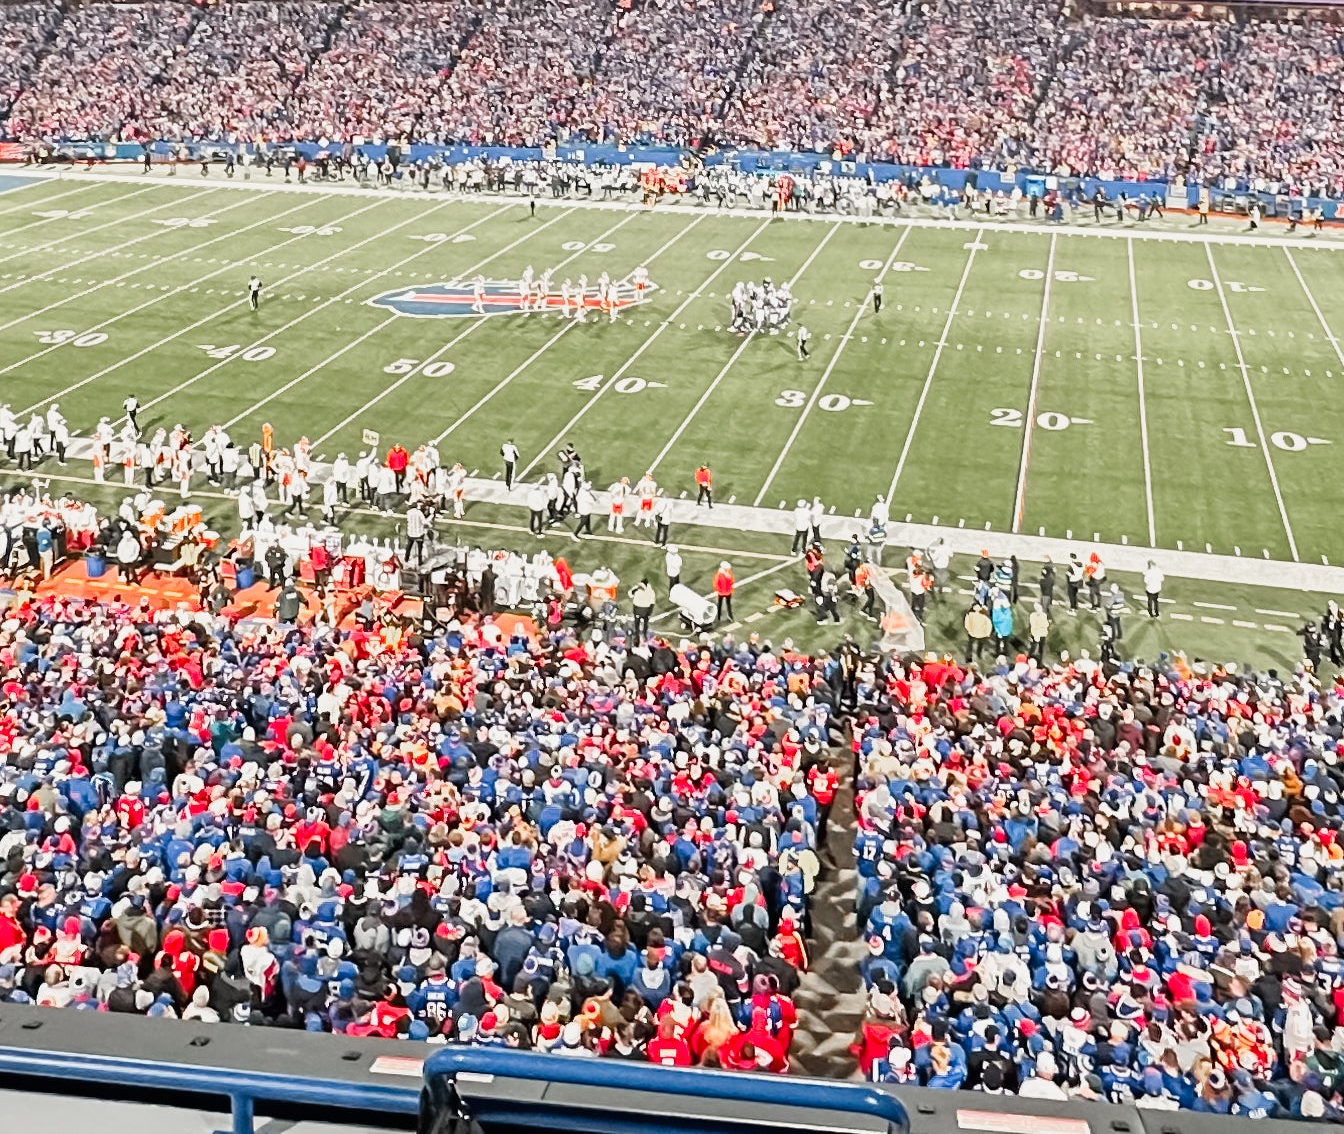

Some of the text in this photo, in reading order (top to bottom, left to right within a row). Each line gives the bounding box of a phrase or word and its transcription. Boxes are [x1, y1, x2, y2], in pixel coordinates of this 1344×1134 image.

[39, 330, 109, 347] 30
[207, 345, 277, 361] 40
[383, 358, 455, 377] 50
[572, 374, 647, 393] 40
[774, 390, 851, 411] 30
[989, 408, 1071, 430] 20
[1222, 428, 1307, 451] 10
